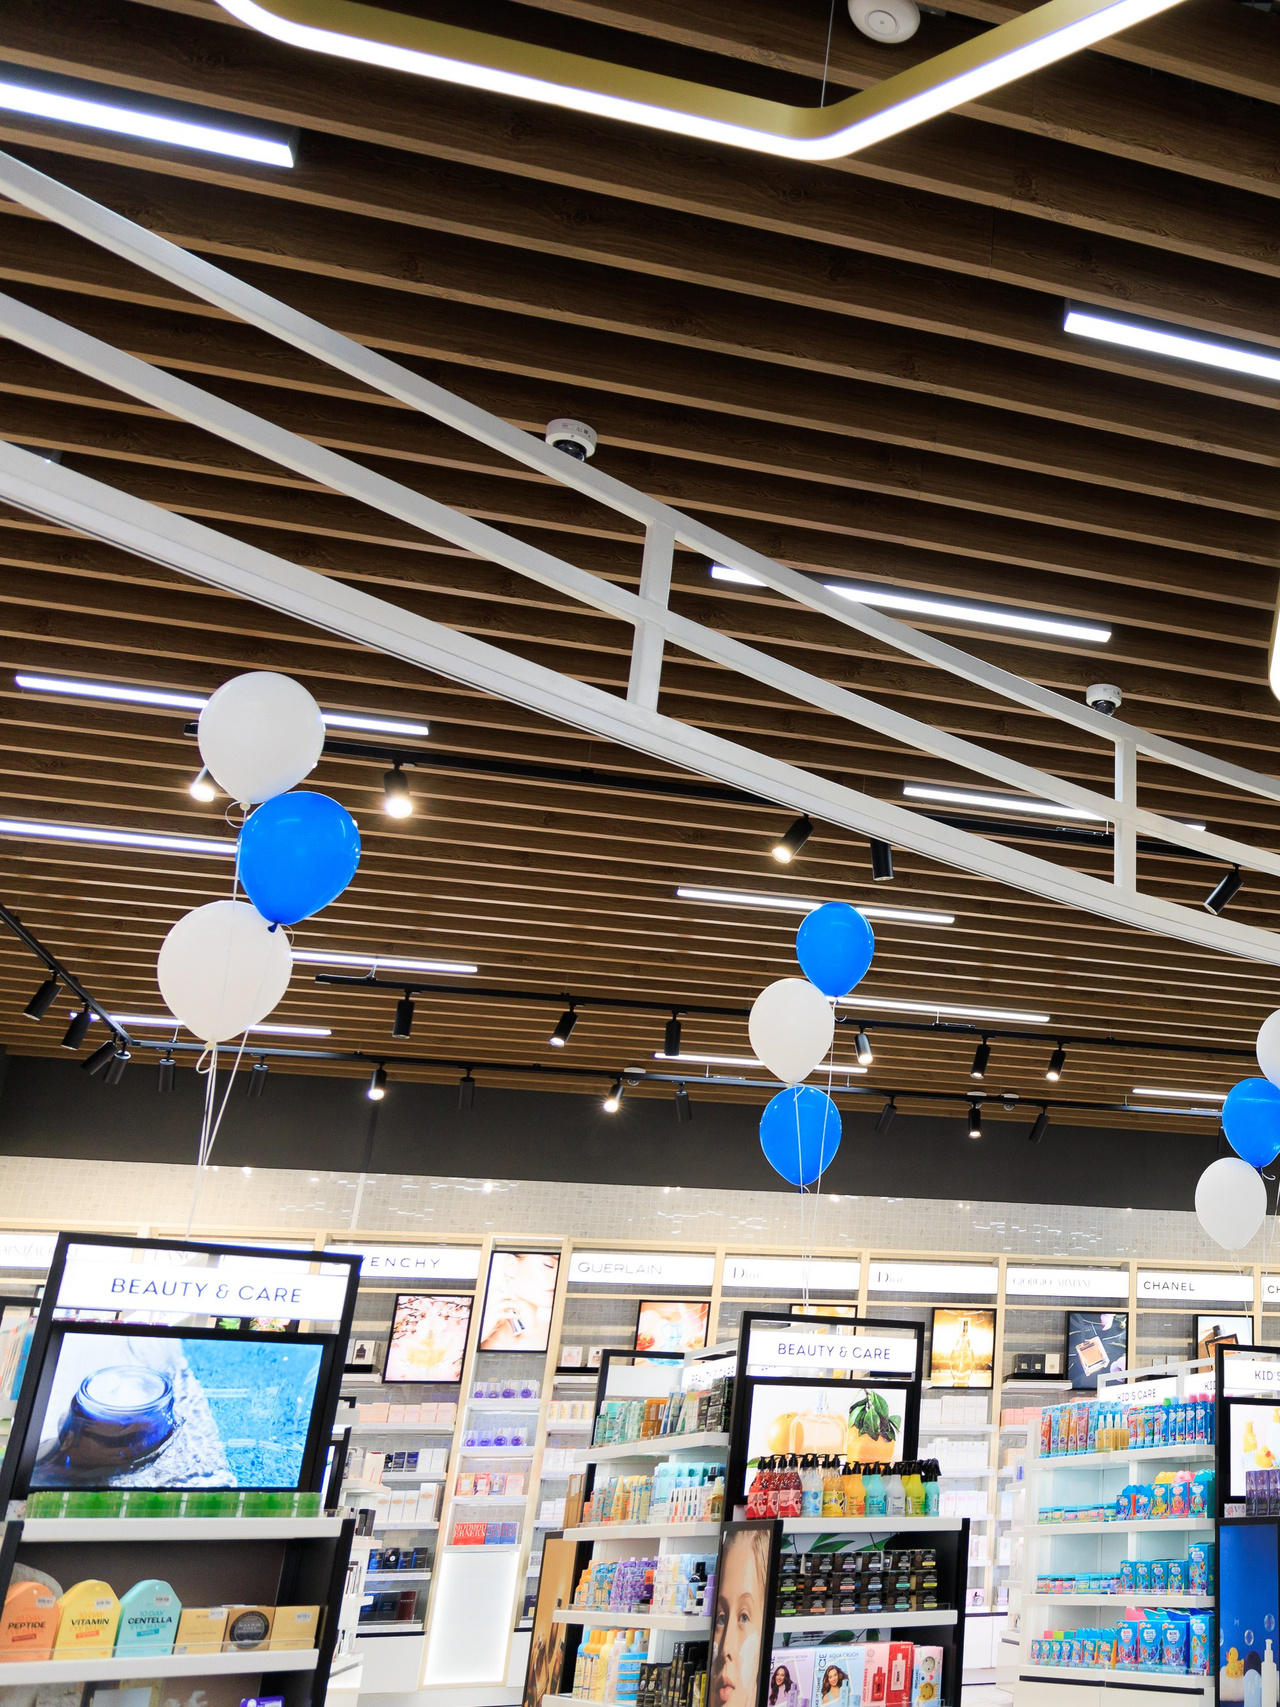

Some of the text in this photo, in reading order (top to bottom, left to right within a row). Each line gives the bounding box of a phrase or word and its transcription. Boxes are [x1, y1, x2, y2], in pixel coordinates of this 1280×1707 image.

[578, 1262, 662, 1275] GUERLAIN
[733, 1266, 761, 1279] Dior
[878, 1270, 903, 1283] Dior
[1012, 1277, 1091, 1288] GIORGIO ARMANI
[110, 1277, 302, 1304] BEAUTY & CARE
[1143, 1280, 1195, 1292] CHANEL
[777, 1342, 891, 1360] BEAUTY & CARE
[1138, 1388, 1157, 1400] CARE
[8, 1621, 46, 1629] PEPTIDE
[71, 1618, 110, 1626] VITAMIN
[127, 1616, 173, 1625] CENTELLA
